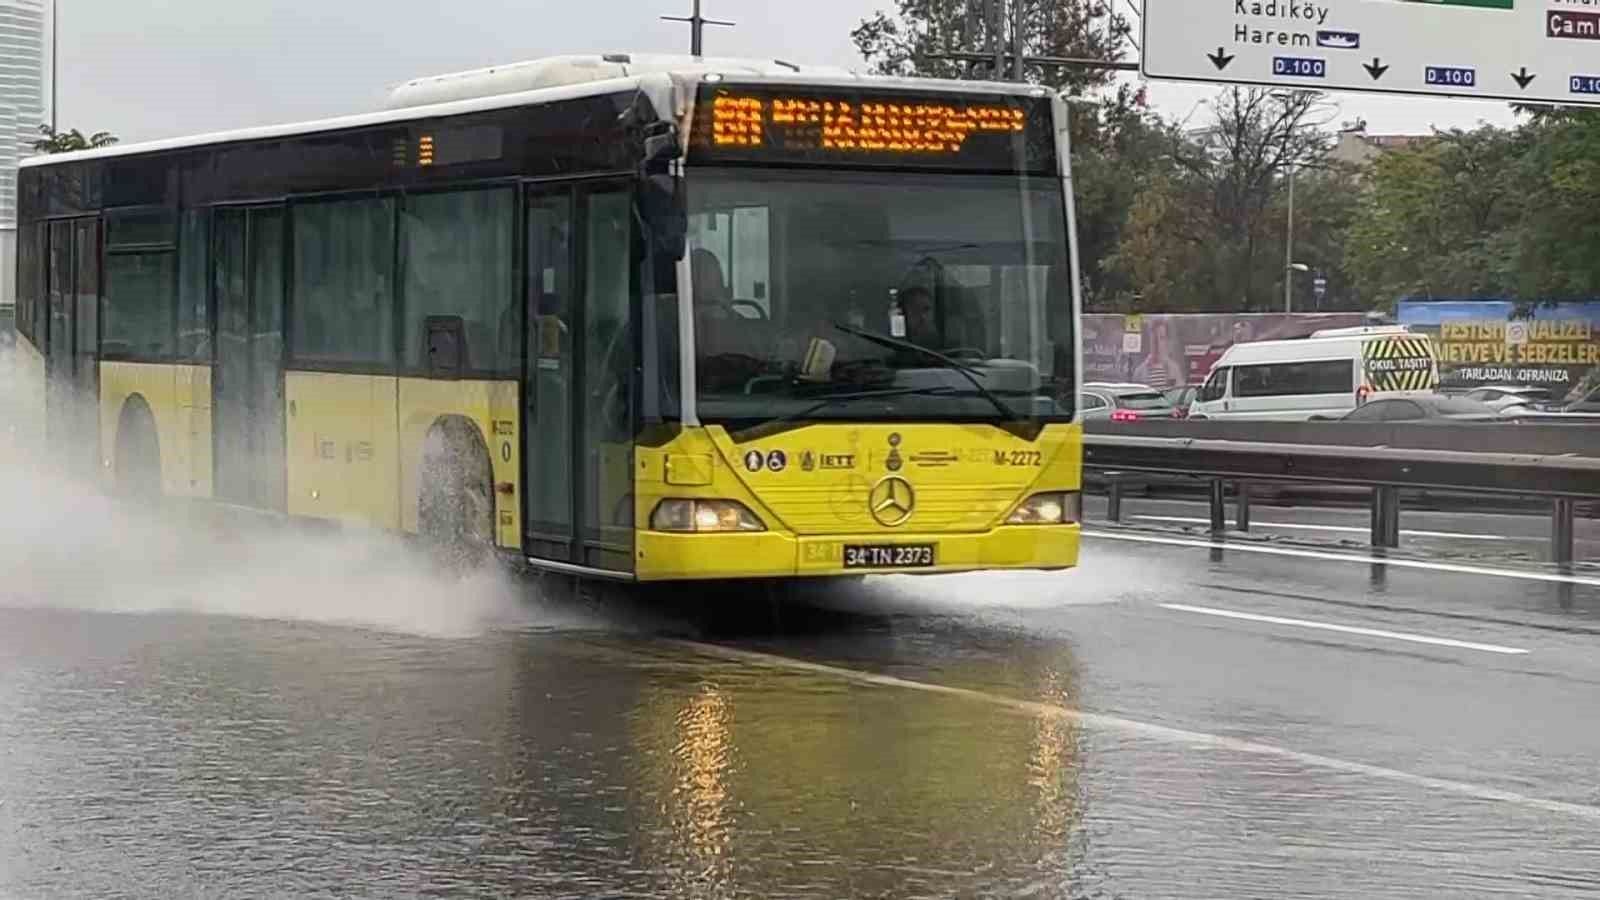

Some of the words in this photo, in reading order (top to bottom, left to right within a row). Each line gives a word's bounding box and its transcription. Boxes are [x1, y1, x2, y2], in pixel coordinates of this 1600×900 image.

[1234, 23, 1310, 46] Harem
[1275, 60, 1323, 74] D.100
[1428, 69, 1472, 84] D.100
[1493, 343, 1514, 363] VE
[1369, 359, 1397, 371] OKUL
[1461, 367, 1512, 381] TARLADAN
[1517, 368, 1569, 382] OFRANIZA
[847, 548, 866, 565] 34
[870, 547, 893, 564] TN
[895, 546, 932, 564] 2373
